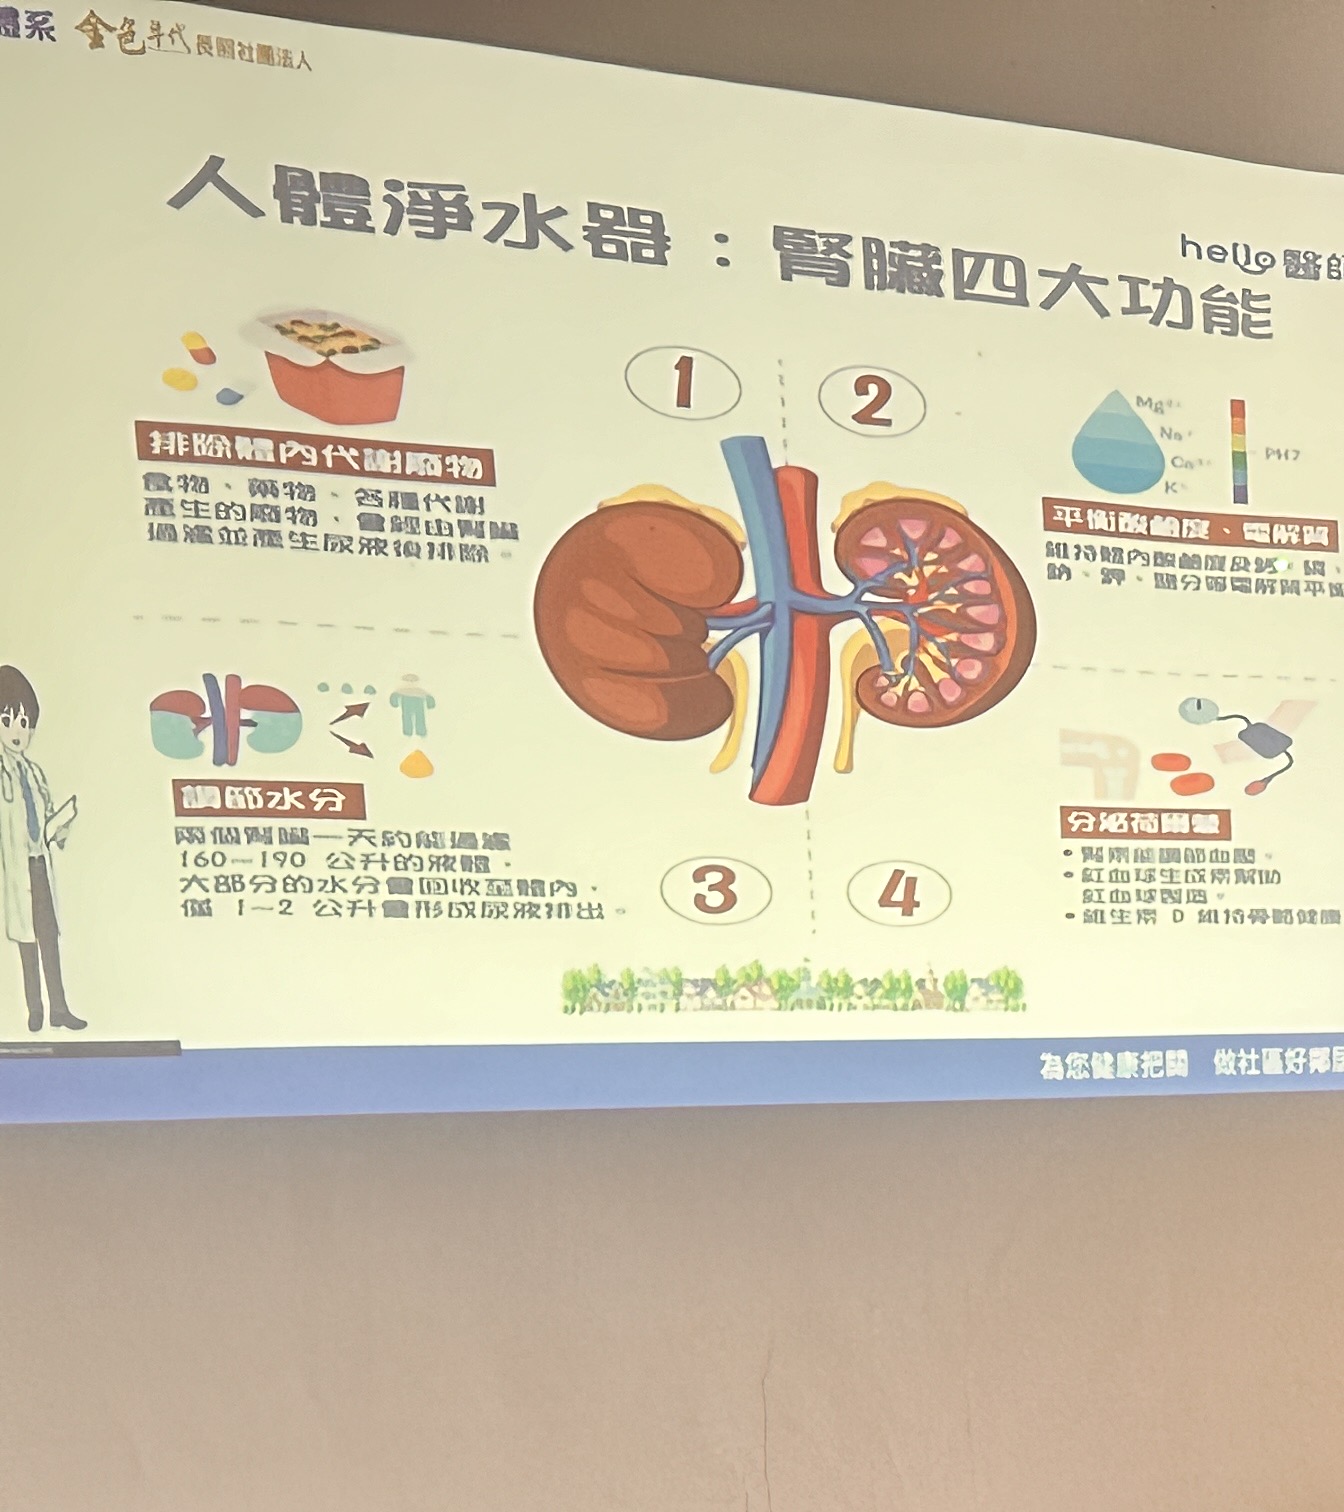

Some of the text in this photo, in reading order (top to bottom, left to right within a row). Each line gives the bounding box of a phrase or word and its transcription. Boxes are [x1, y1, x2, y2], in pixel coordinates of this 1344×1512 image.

[674, 356, 694, 408] 1
[850, 374, 892, 427] 2
[1067, 811, 1220, 834] 分泌荷爾
[692, 864, 738, 915] 3
[877, 868, 920, 917] 4
